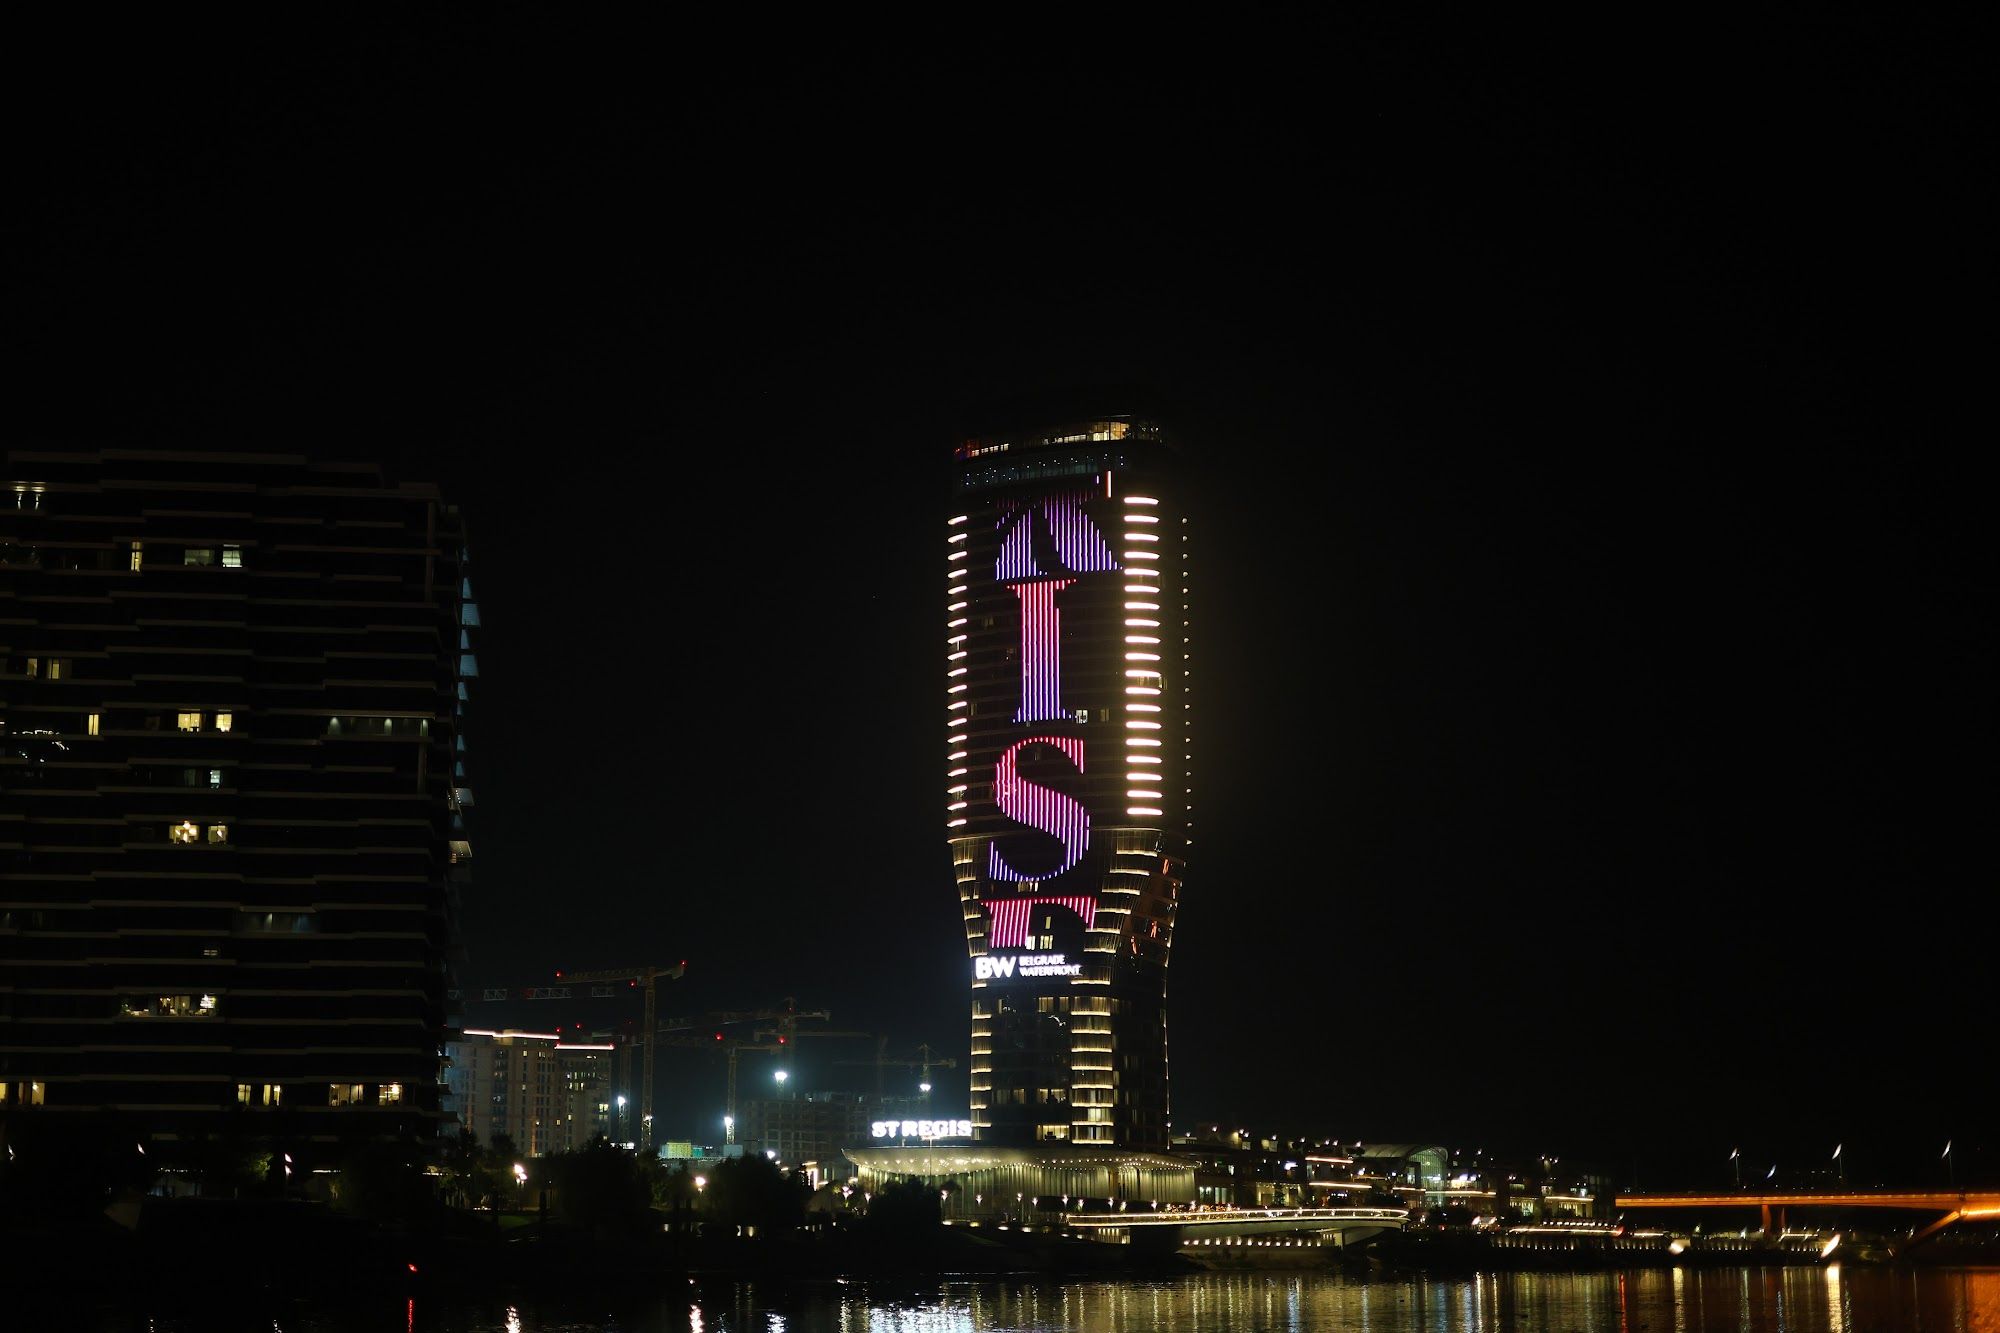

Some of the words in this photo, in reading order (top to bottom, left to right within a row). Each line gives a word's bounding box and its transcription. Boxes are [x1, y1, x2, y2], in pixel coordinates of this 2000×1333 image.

[1019, 954, 1066, 965] BELGRADE
[975, 956, 1016, 979] BW
[1019, 964, 1083, 976] WATERFRONT
[871, 1121, 900, 1138] ST
[901, 1119, 972, 1137] REGIS
